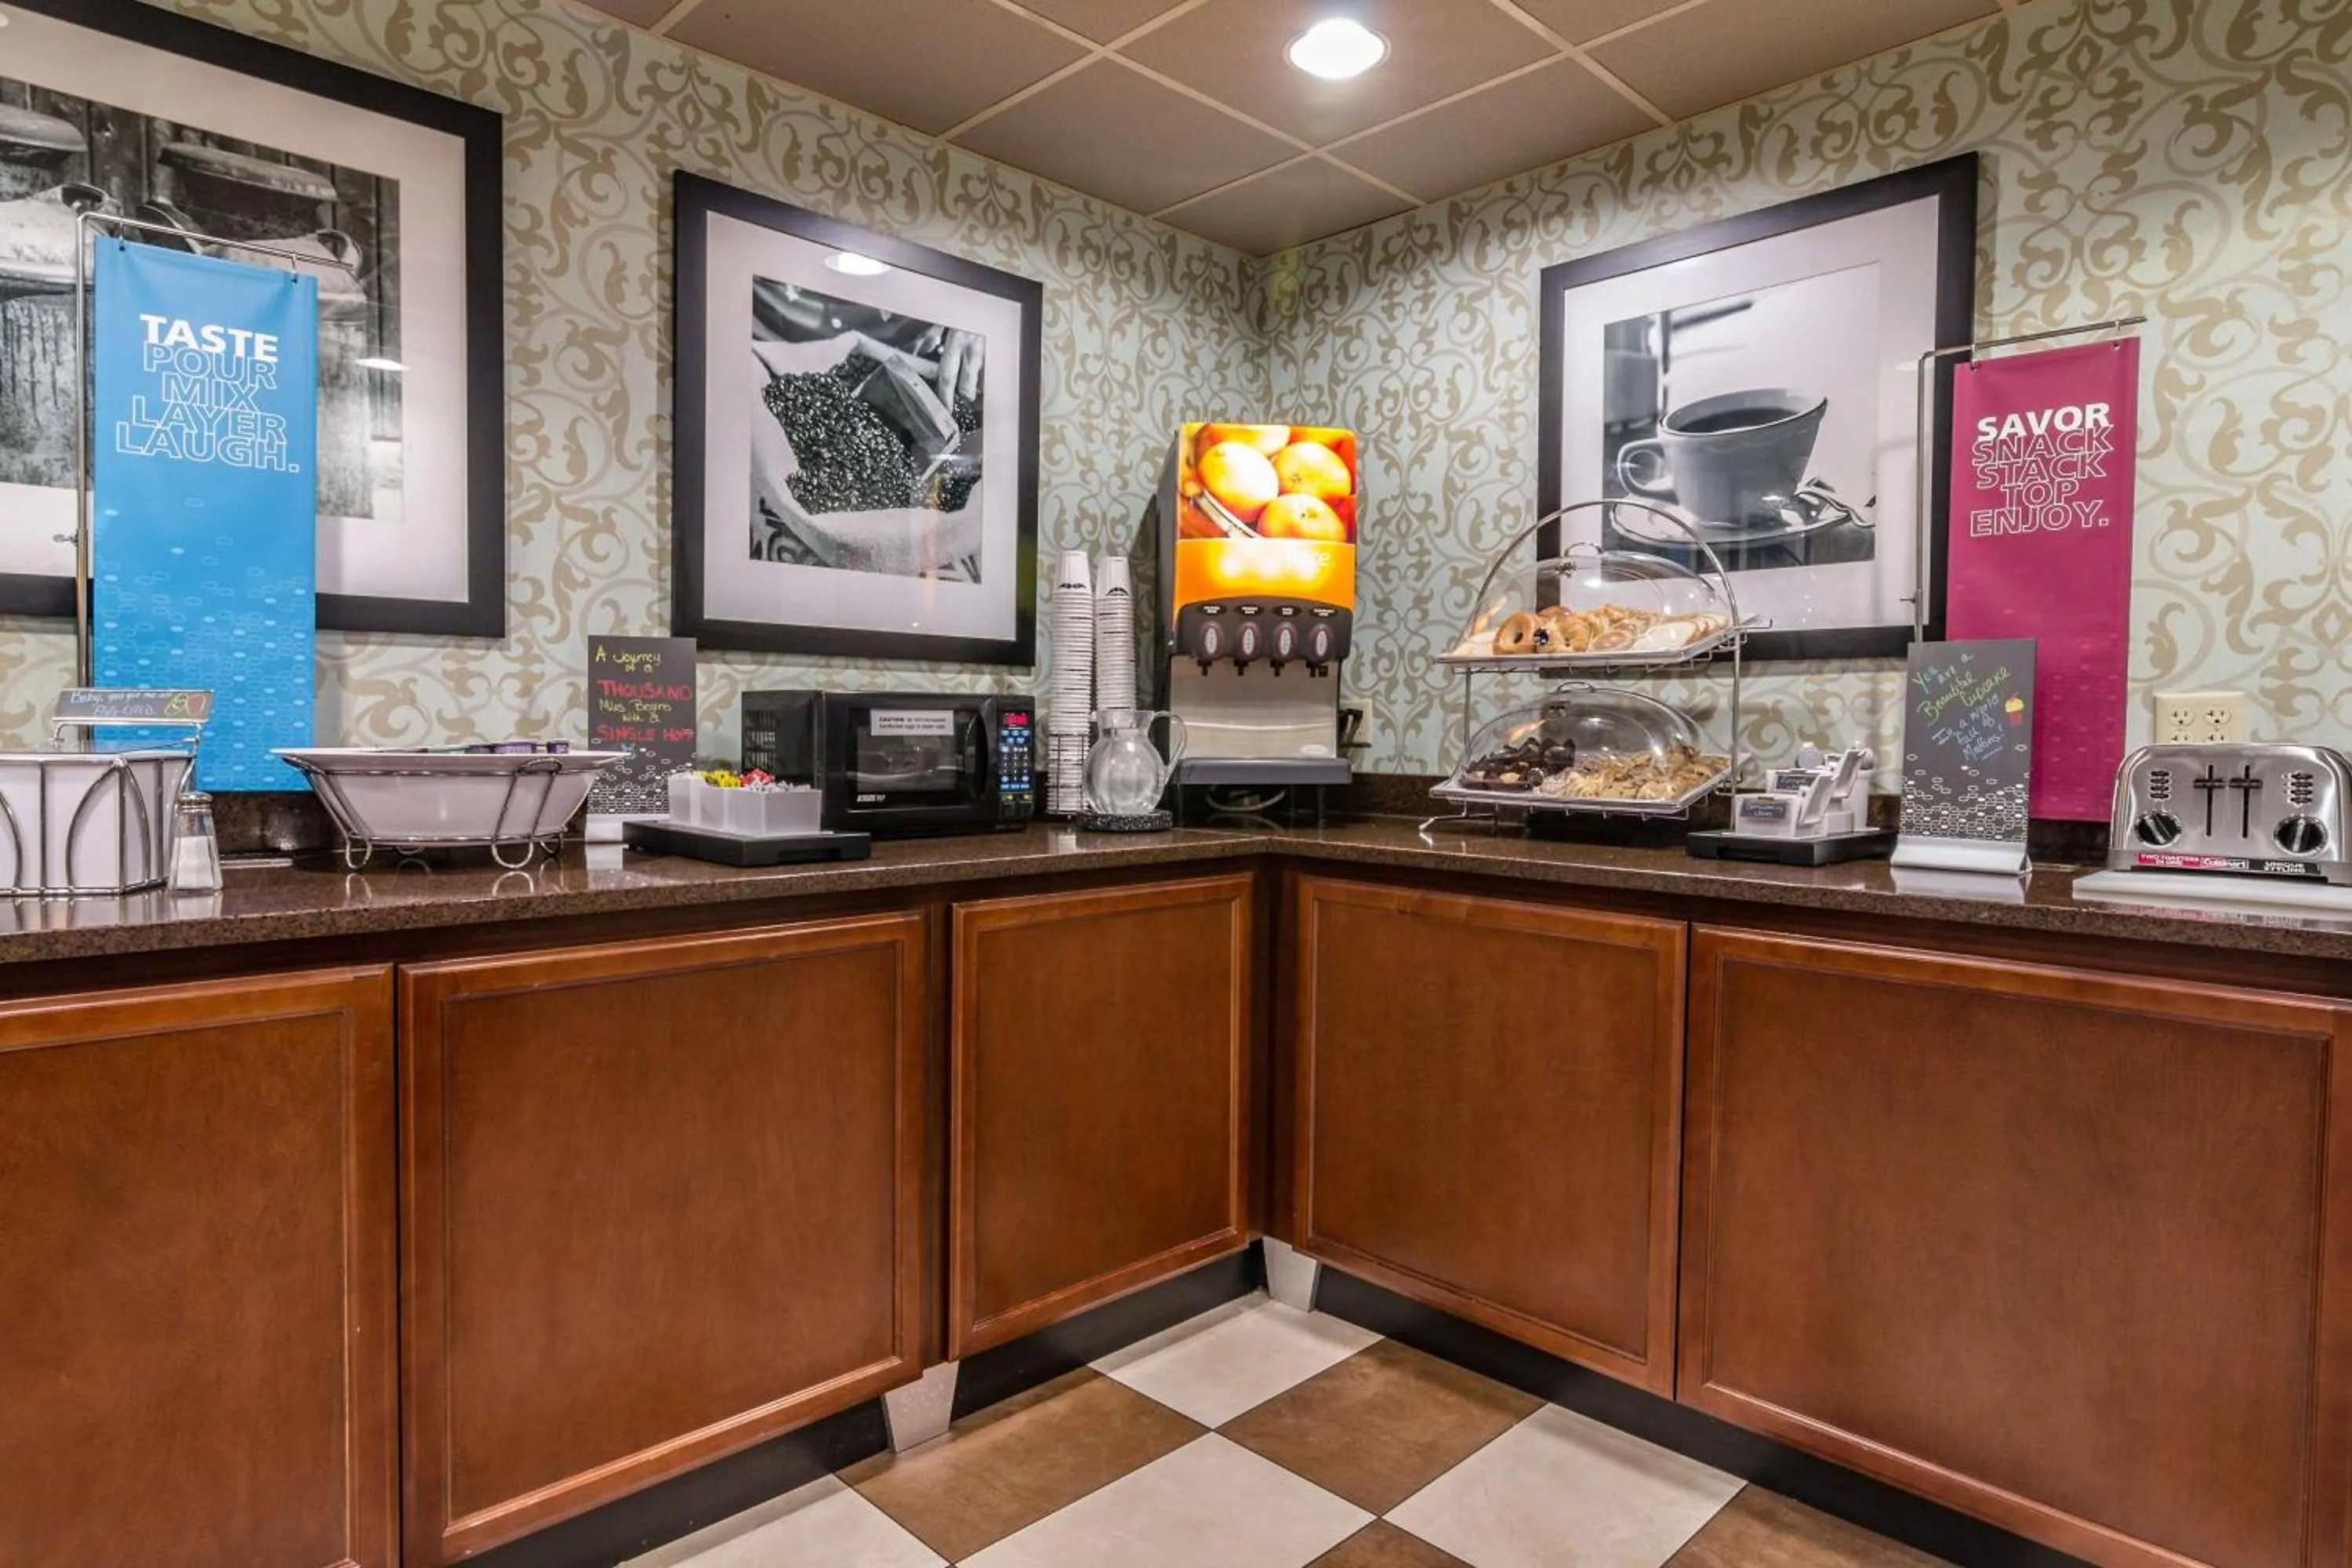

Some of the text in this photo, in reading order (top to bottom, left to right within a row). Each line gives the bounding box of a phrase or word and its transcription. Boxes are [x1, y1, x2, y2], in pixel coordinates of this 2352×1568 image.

[140, 314, 278, 362] TASTE
[143, 341, 277, 390] POUR
[162, 371, 259, 412] MIX
[132, 395, 287, 445] LAYER
[1977, 402, 2111, 442] SAVOR
[116, 421, 299, 472] LAUGH.
[1972, 424, 2114, 466] SNACK
[1976, 450, 2107, 489] STACK
[2000, 477, 2080, 509] TOP
[1970, 499, 2109, 537] ENJOY.
[595, 644, 607, 662] A
[644, 664, 653, 673] a
[597, 679, 693, 701] THOUSAND
[596, 724, 655, 742] SINGLE
